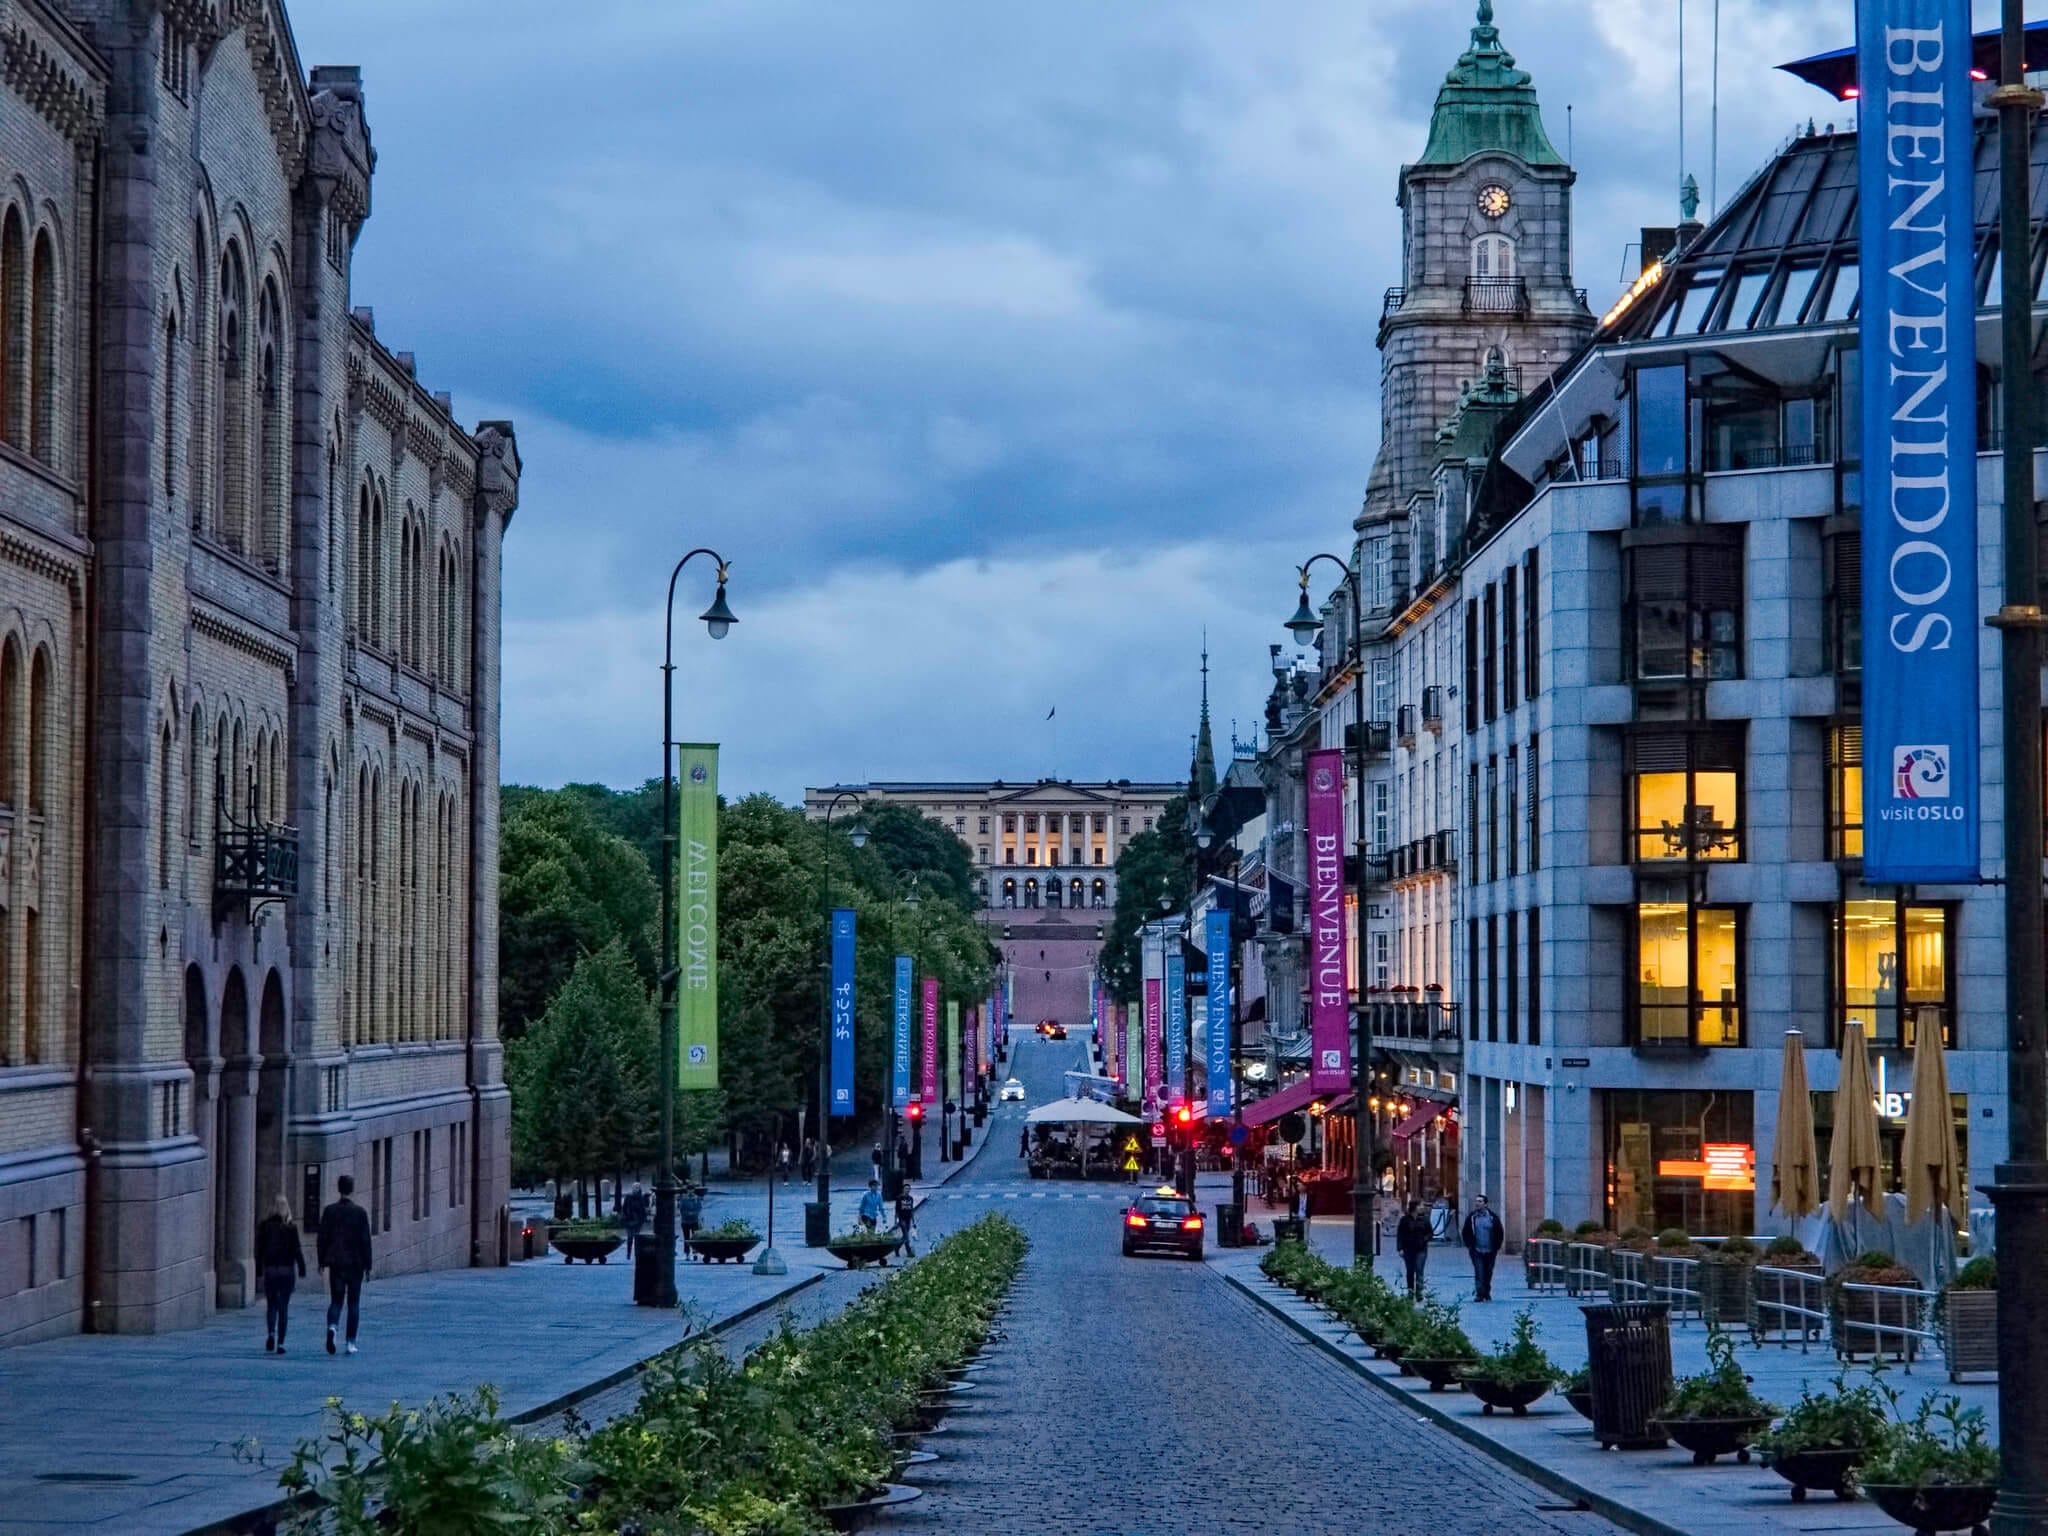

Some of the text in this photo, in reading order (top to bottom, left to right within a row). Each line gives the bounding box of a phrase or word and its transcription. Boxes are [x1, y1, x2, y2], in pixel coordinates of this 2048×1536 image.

[1885, 20, 1952, 653] BIENVENIDOS
[1315, 834, 1342, 1008] BIENVENUE
[1149, 1003, 1158, 1078] WILLKOMMEN
[1171, 988, 1182, 1072] VELKOMMEN
[1212, 952, 1225, 1073] BIENVENIDOS
